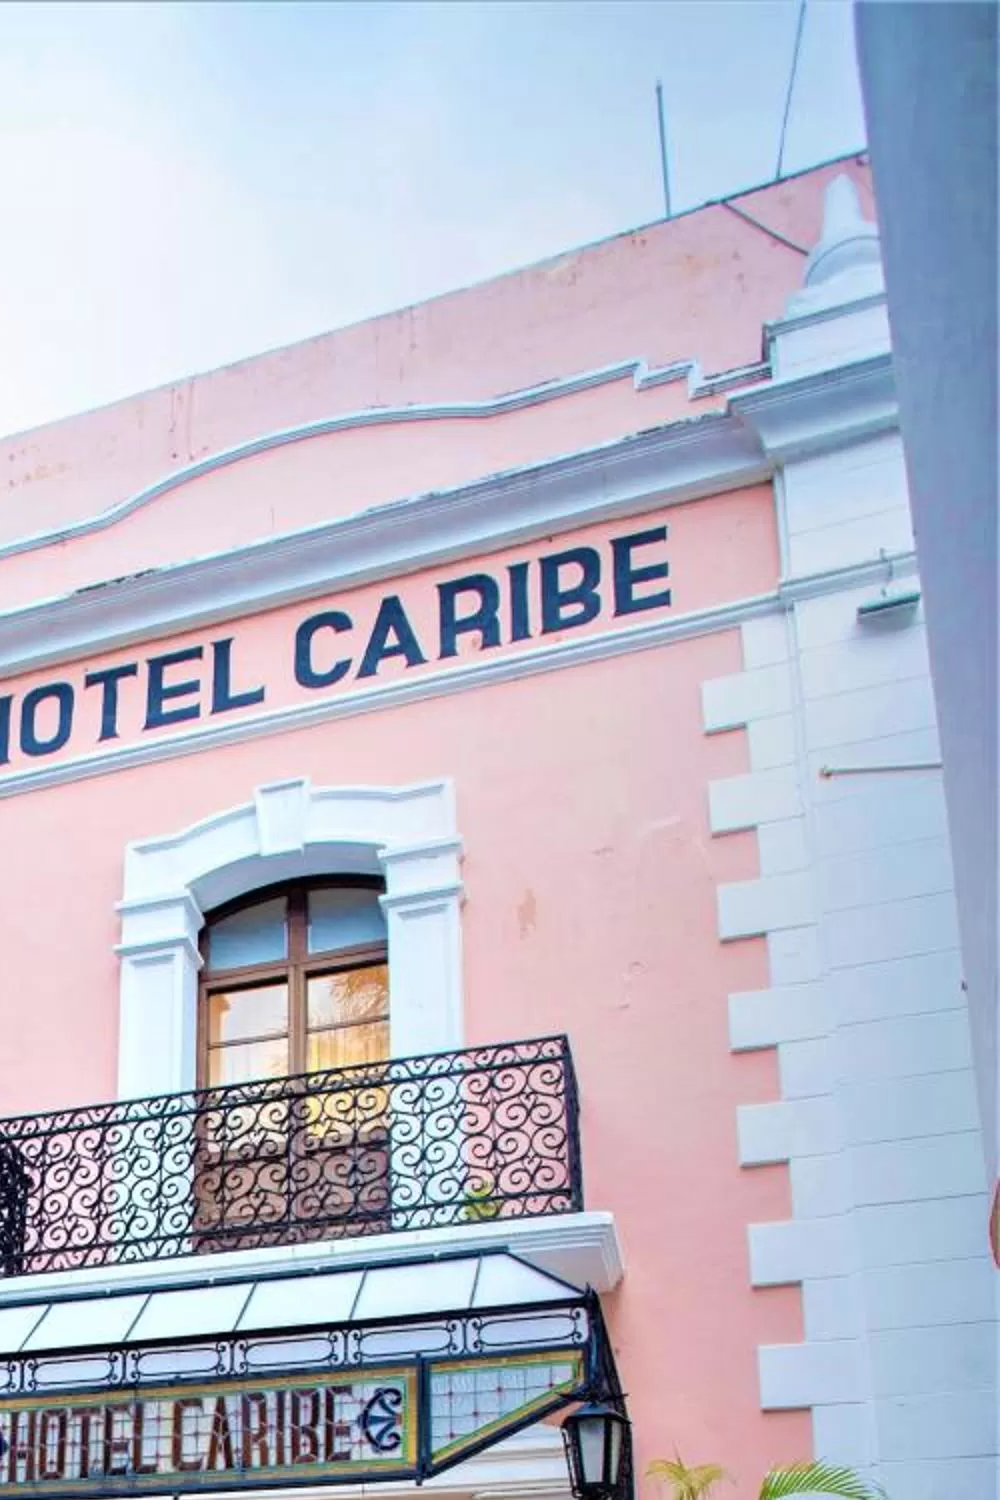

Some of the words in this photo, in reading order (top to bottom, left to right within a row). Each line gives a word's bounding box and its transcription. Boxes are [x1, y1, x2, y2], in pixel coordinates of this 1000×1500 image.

[293, 525, 671, 689] CARIBE
[8, 1400, 163, 1482] HOTEL
[171, 1385, 358, 1471] CARIBE
